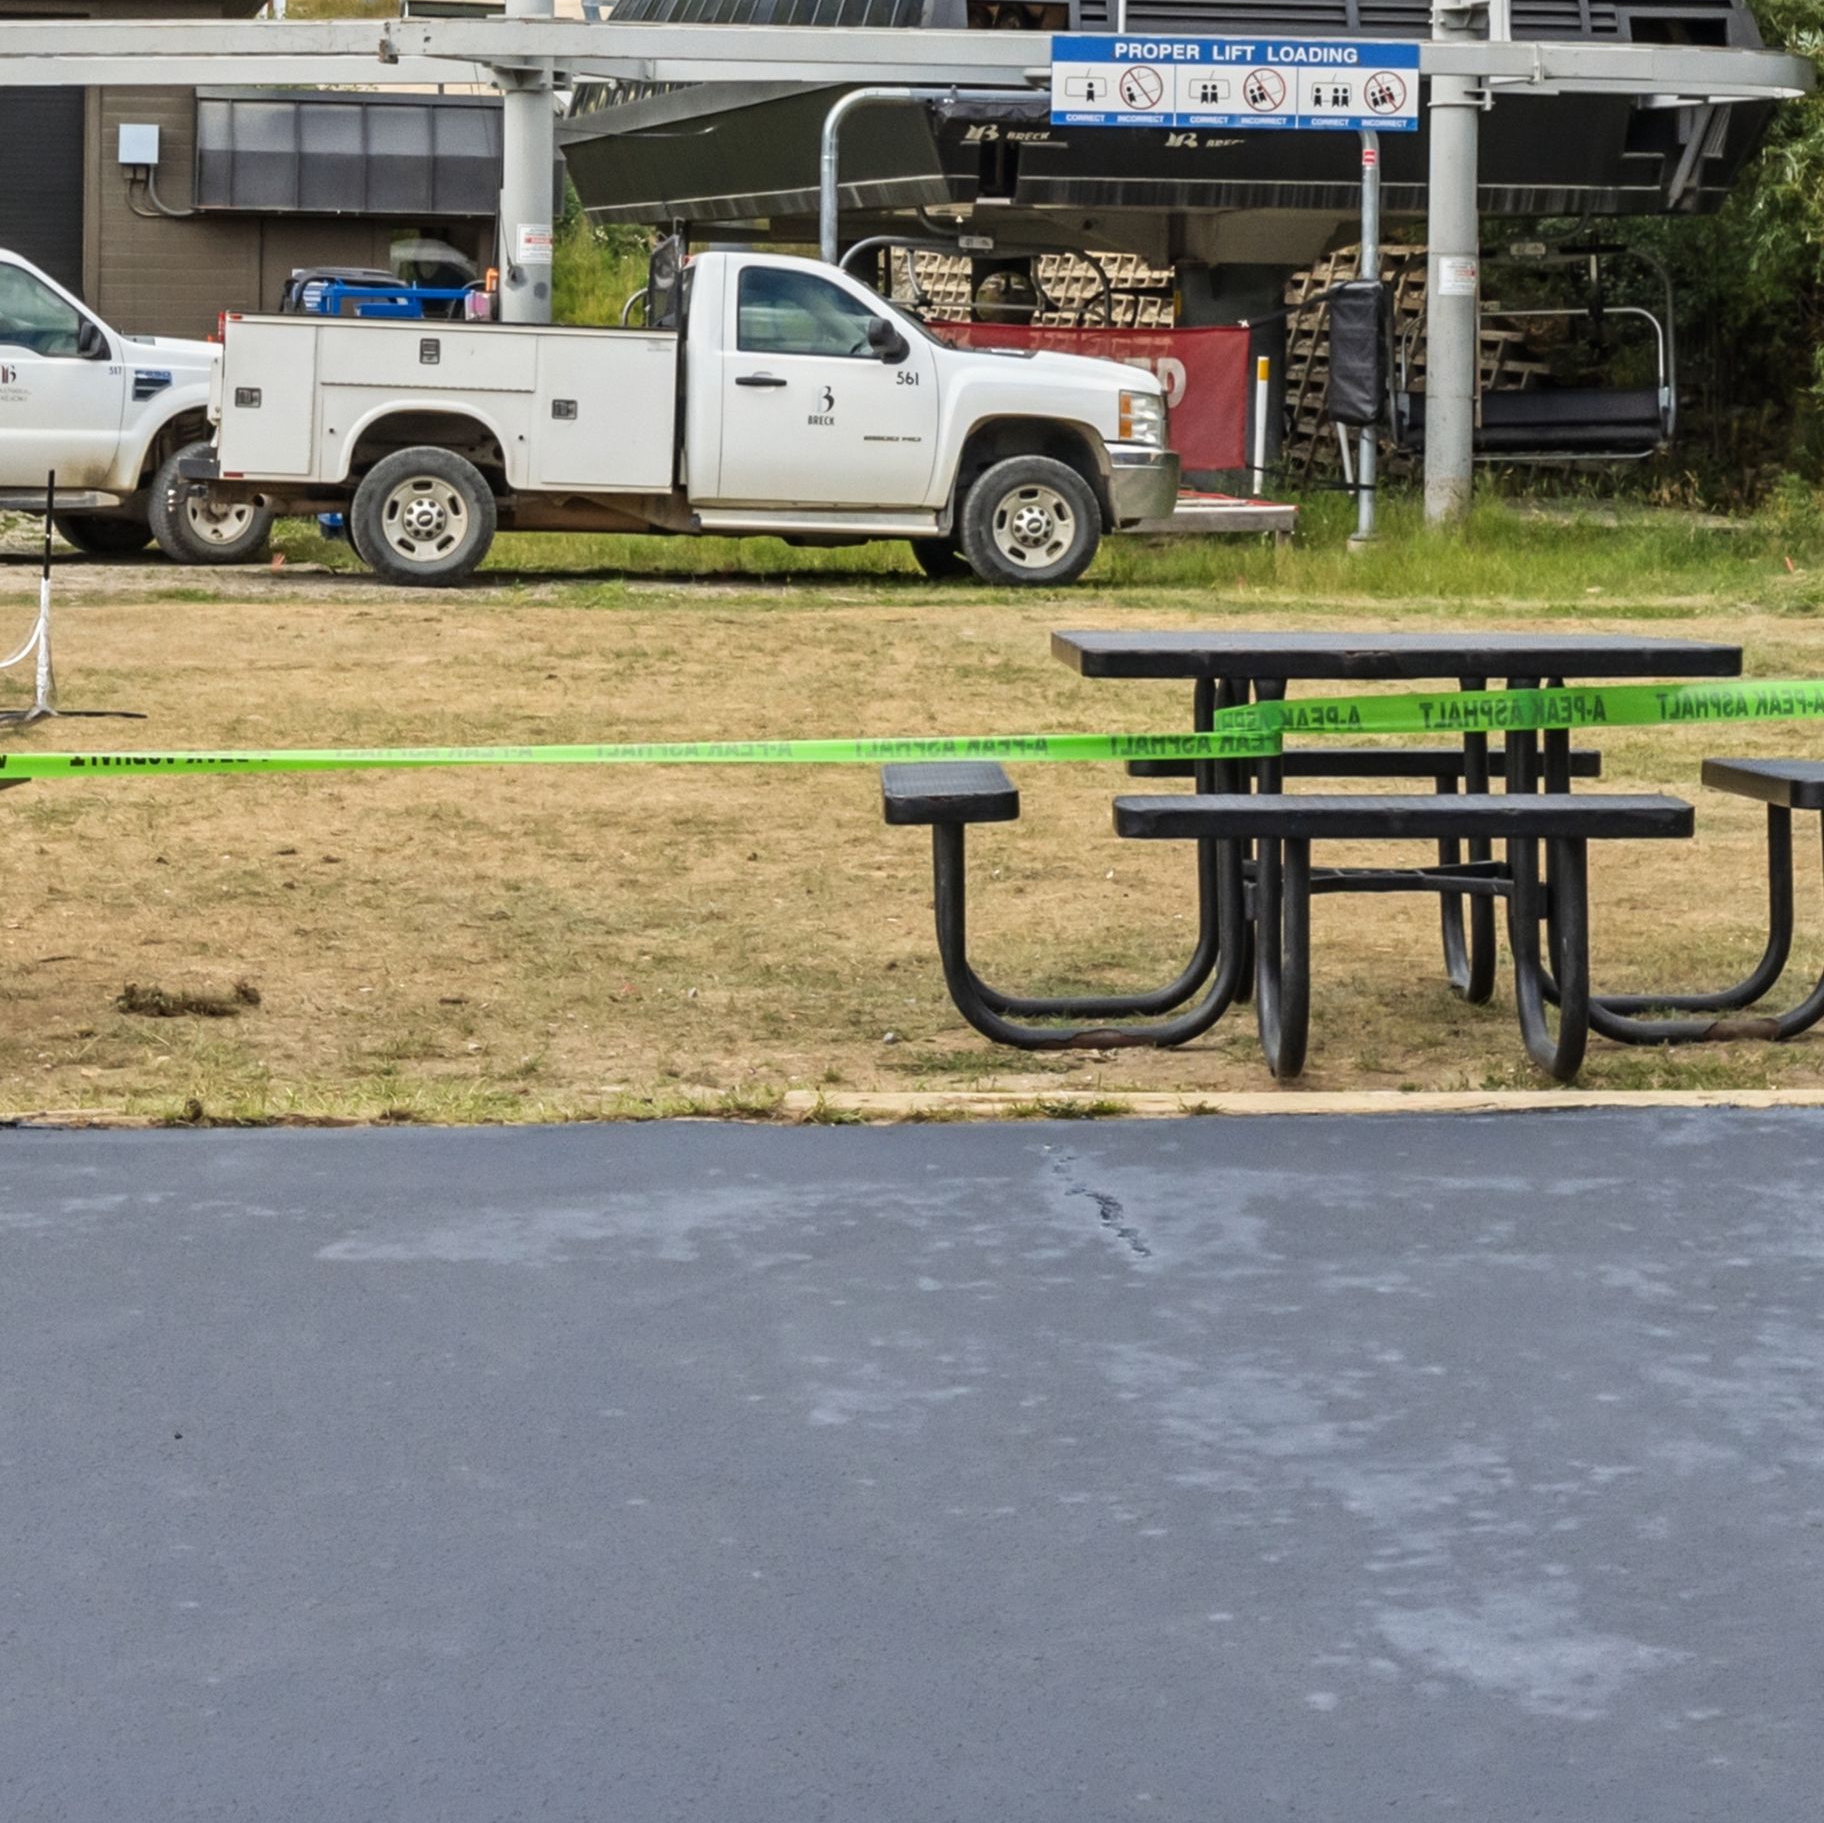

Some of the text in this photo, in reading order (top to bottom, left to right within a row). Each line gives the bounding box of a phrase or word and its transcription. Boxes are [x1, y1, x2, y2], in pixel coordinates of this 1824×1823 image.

[1113, 42, 1358, 64] PROPER LIFT LOADING
[1065, 113, 1105, 122] CORRECT
[1117, 115, 1164, 123] INCORRECT
[1189, 115, 1229, 124] CORRECT
[1240, 117, 1287, 125] INCORRECT
[1311, 118, 1350, 126] CORRECT
[1361, 119, 1407, 128] INCORRECT
[108, 366, 123, 376] 517
[896, 371, 919, 386] 561
[808, 415, 835, 426] BRECK
